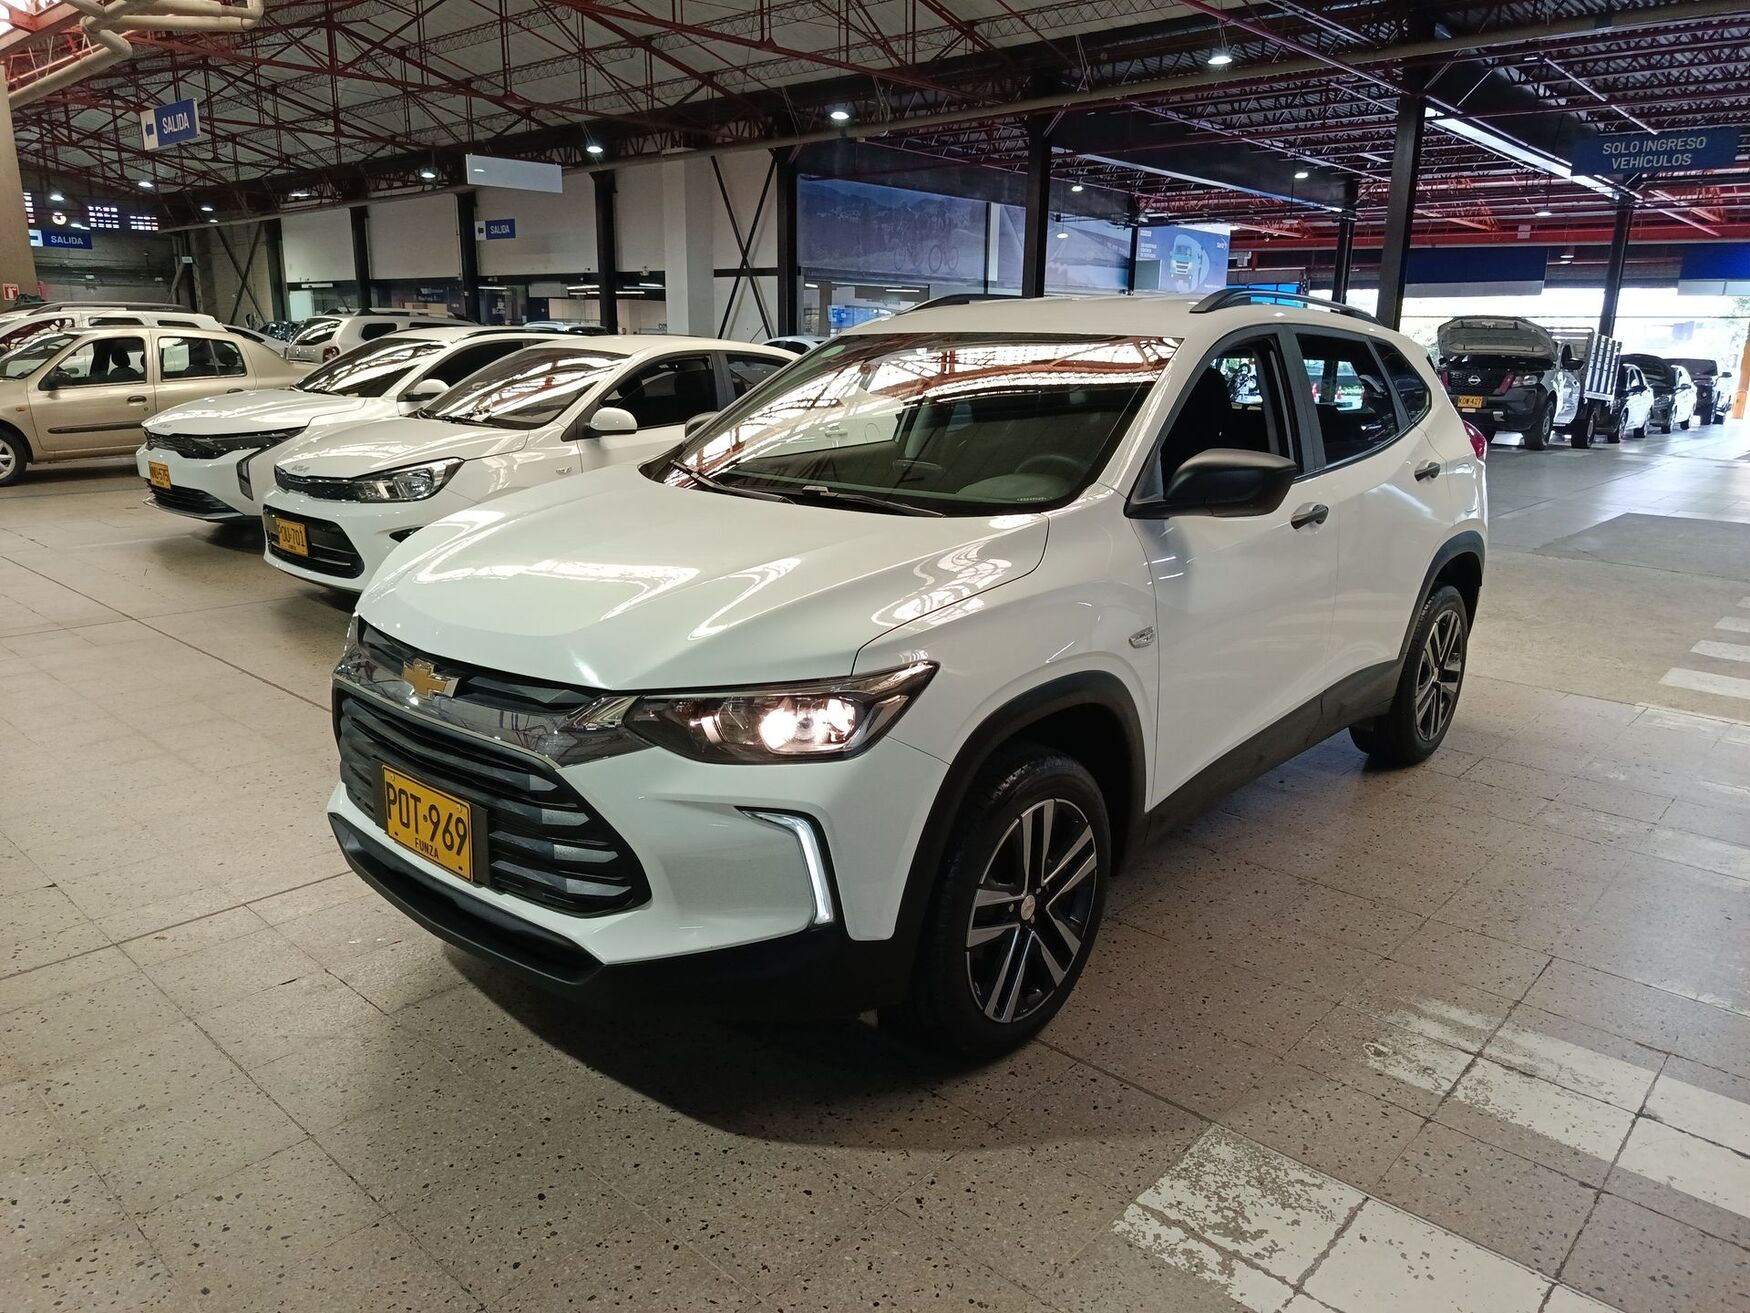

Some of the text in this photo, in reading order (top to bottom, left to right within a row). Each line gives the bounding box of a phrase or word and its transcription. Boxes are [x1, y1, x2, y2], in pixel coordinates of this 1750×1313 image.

[163, 113, 189, 133] SALIDA
[1602, 137, 1706, 154] SOLO INGRESO
[1612, 154, 1691, 169] VEHÍCULOS
[490, 225, 509, 234] SALIDA
[51, 235, 83, 245] SALIDA
[416, 838, 438, 858] FUNZA
